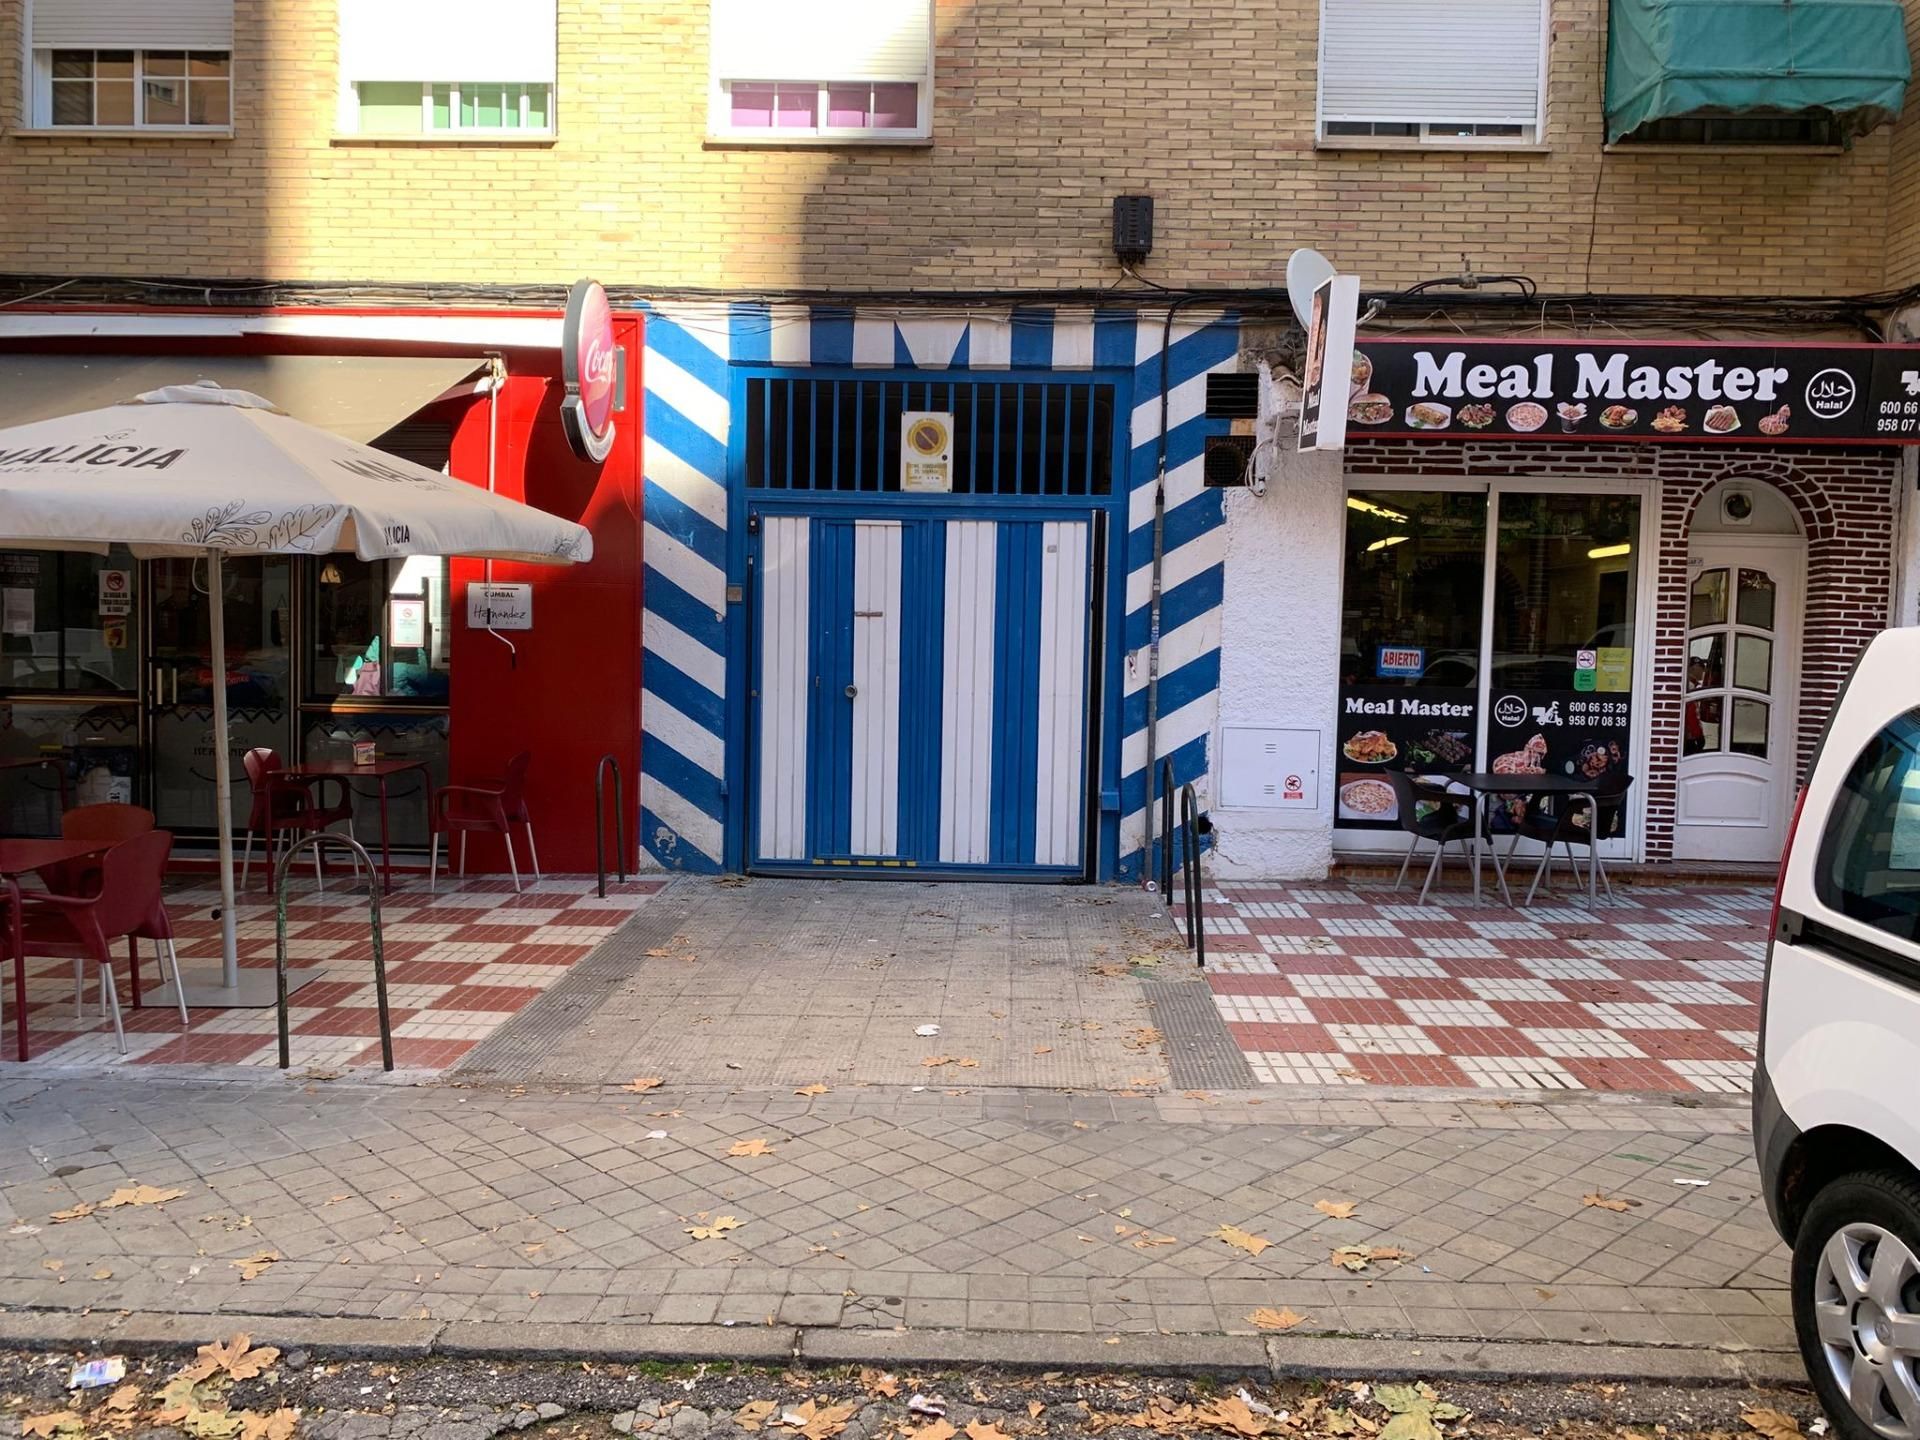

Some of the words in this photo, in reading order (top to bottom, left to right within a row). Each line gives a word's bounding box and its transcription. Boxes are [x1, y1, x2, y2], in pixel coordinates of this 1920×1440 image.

[1411, 351, 1554, 399] Meal
[1573, 353, 1789, 401] Master
[1816, 401, 1843, 409] Halal
[1880, 401, 1901, 414] 600
[1904, 401, 1919, 414] 66
[1877, 418, 1899, 432] 958
[1901, 419, 1917, 432] 07
[1383, 651, 1420, 666] ABIERTO
[1345, 697, 1395, 715] Meal
[1400, 699, 1474, 717] Master
[1569, 702, 1587, 712] 600
[1588, 702, 1600, 713] 66
[1602, 703, 1614, 713] 35
[1615, 703, 1628, 713] 29
[1568, 715, 1586, 726] 958
[1588, 716, 1600, 726] 07
[1601, 716, 1613, 727] 08
[1615, 716, 1627, 727] 38
